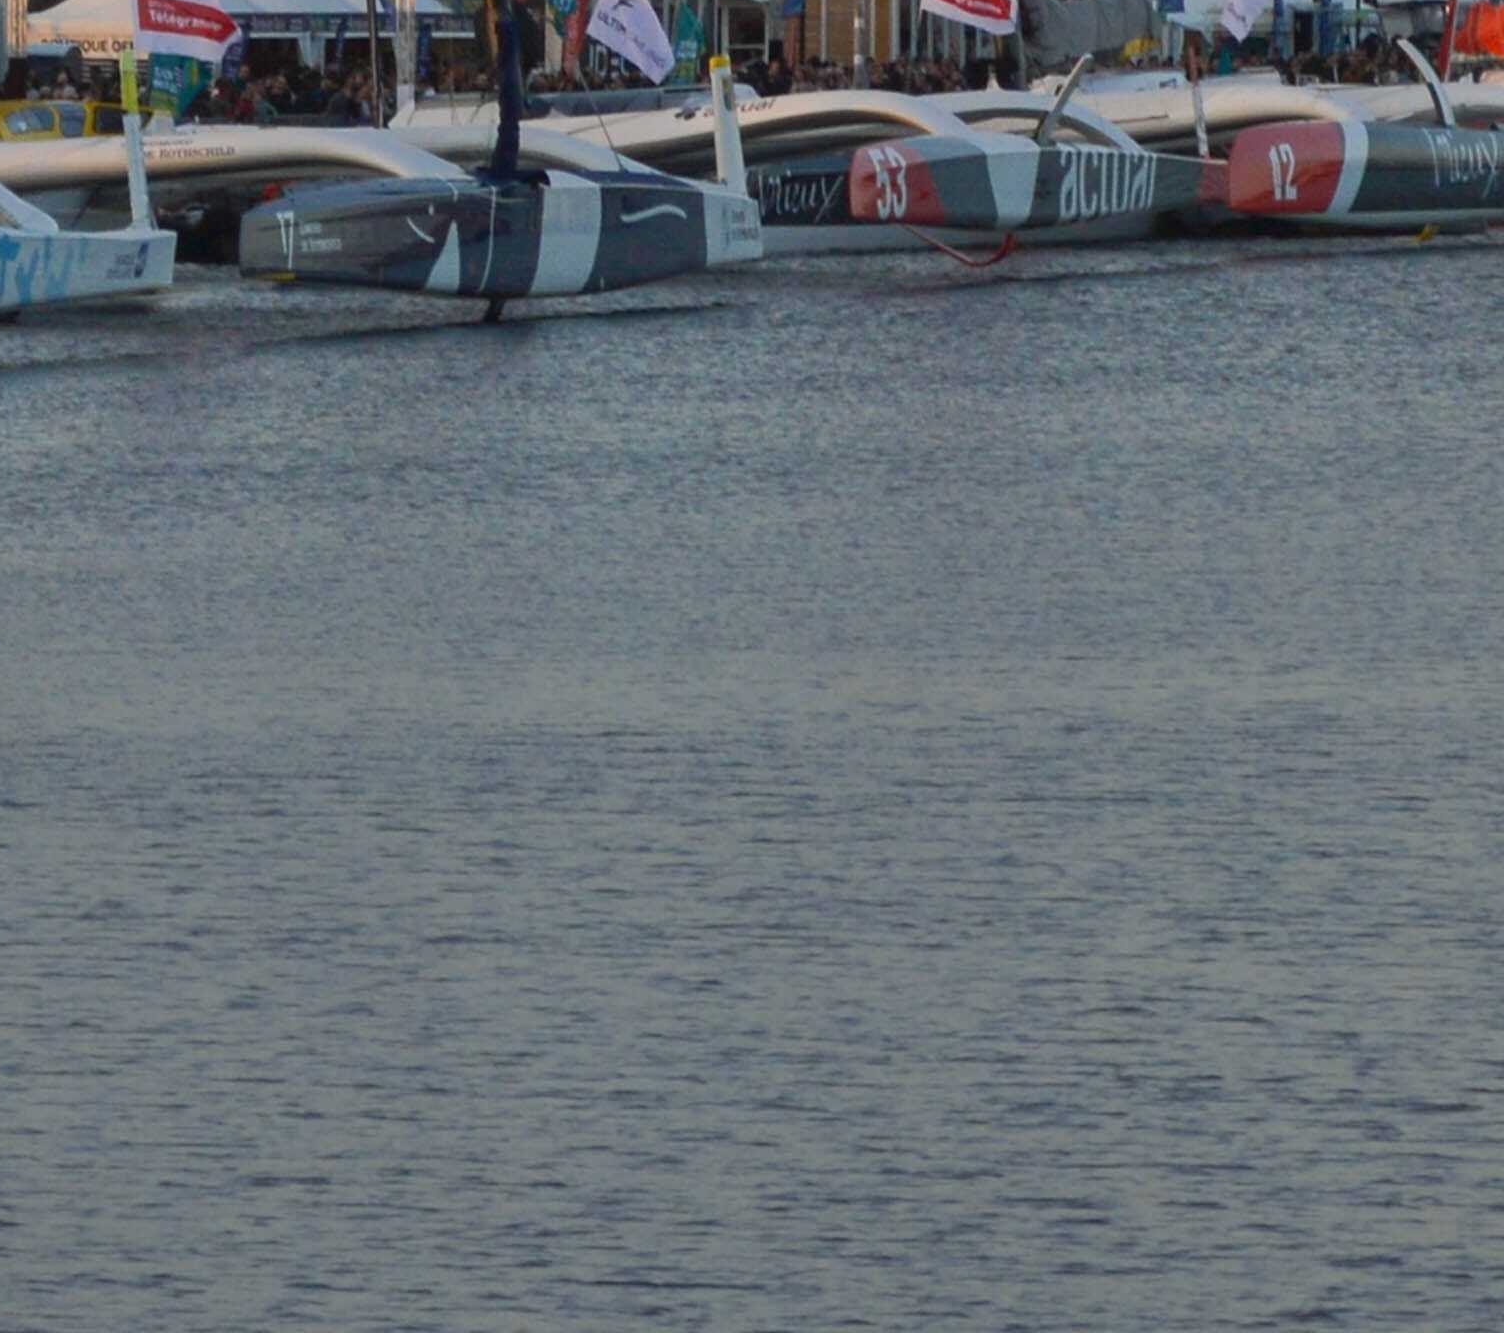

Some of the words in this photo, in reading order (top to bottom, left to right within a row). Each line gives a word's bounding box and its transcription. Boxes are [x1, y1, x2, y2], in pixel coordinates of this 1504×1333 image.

[159, 146, 236, 160] ROTHSCHILD
[1269, 142, 1297, 202] 12
[871, 147, 908, 220] 53
